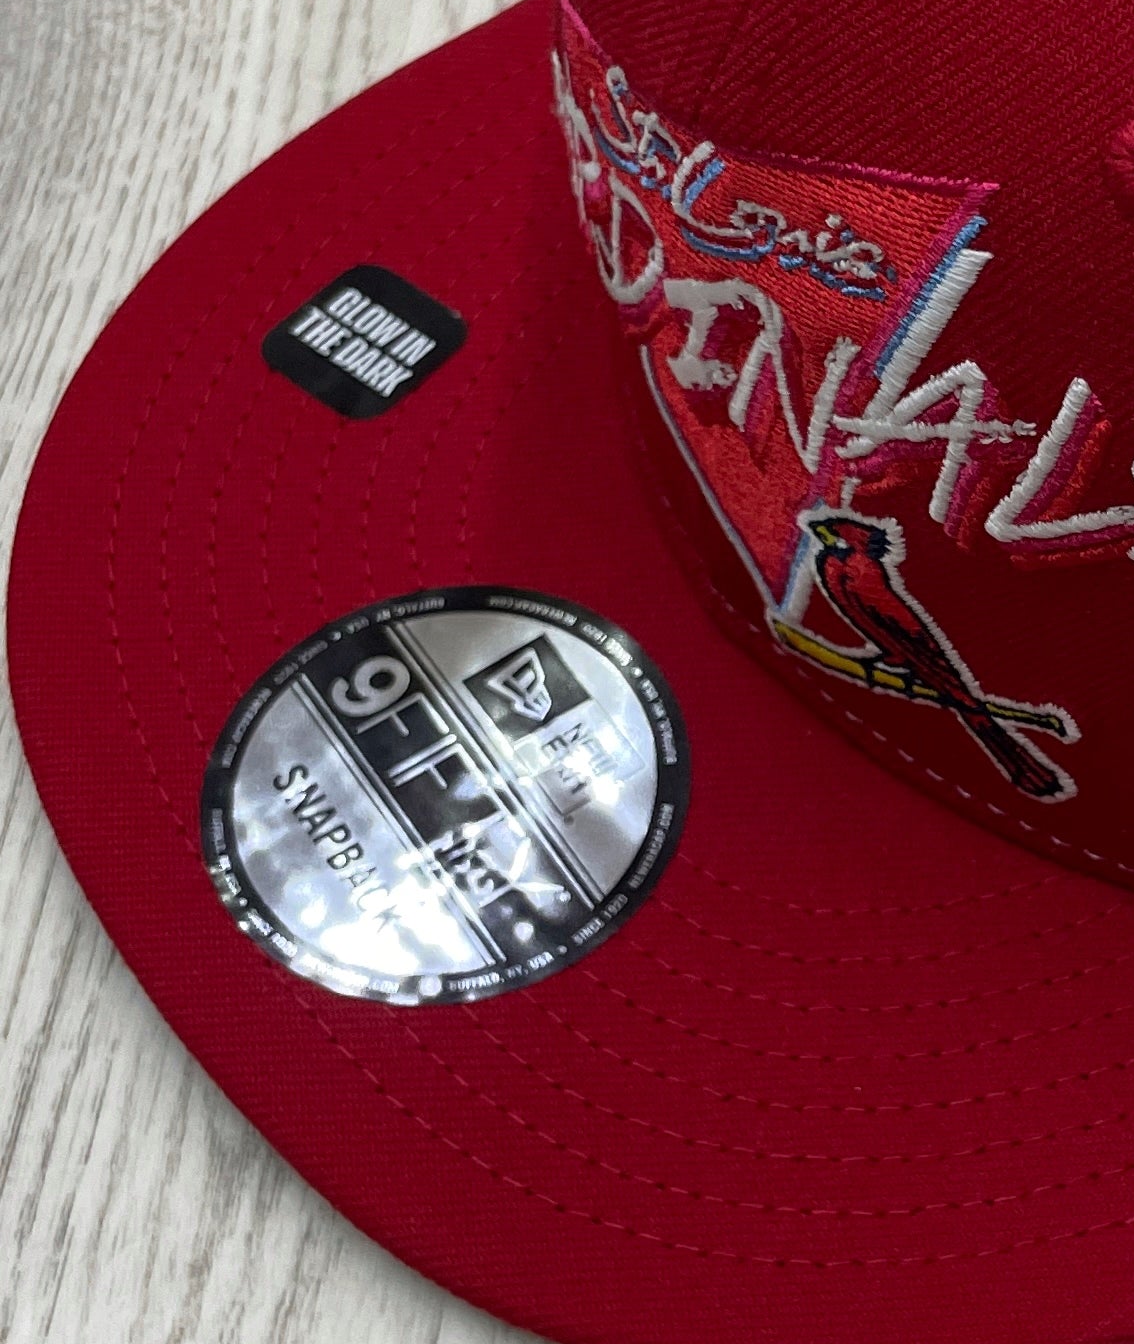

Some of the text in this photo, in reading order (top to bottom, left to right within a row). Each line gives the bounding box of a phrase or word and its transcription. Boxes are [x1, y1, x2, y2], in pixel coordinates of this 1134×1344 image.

[671, 139, 886, 283] Louis
[289, 305, 415, 399] THE DARK
[326, 286, 438, 368] GLOW IN
